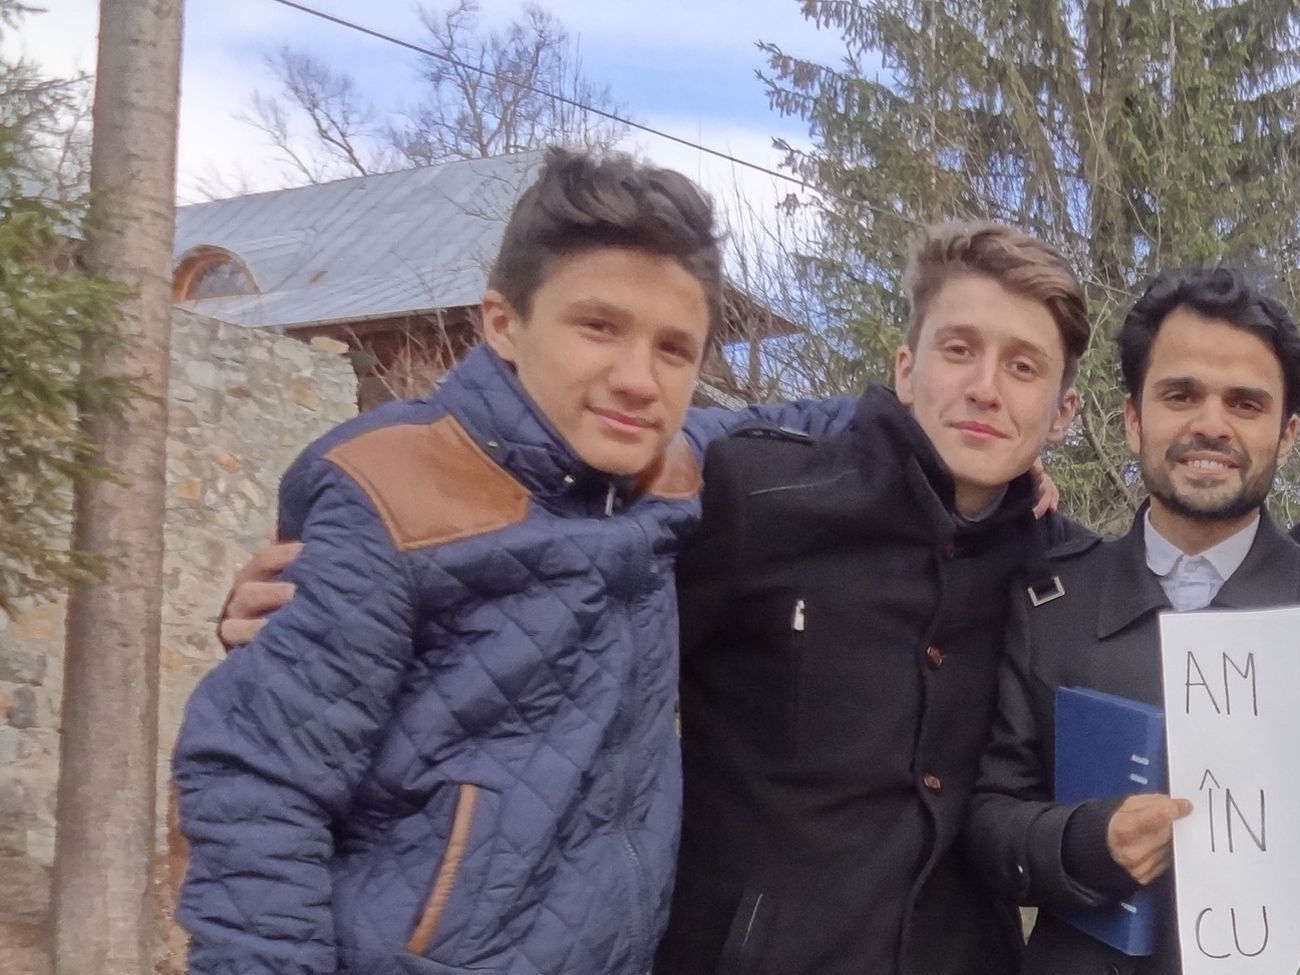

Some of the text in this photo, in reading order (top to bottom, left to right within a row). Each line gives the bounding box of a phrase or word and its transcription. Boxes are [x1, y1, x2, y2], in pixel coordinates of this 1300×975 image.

[1184, 650, 1259, 717] AM
[1198, 768, 1267, 853] ÎN
[1194, 905, 1270, 960] CU
